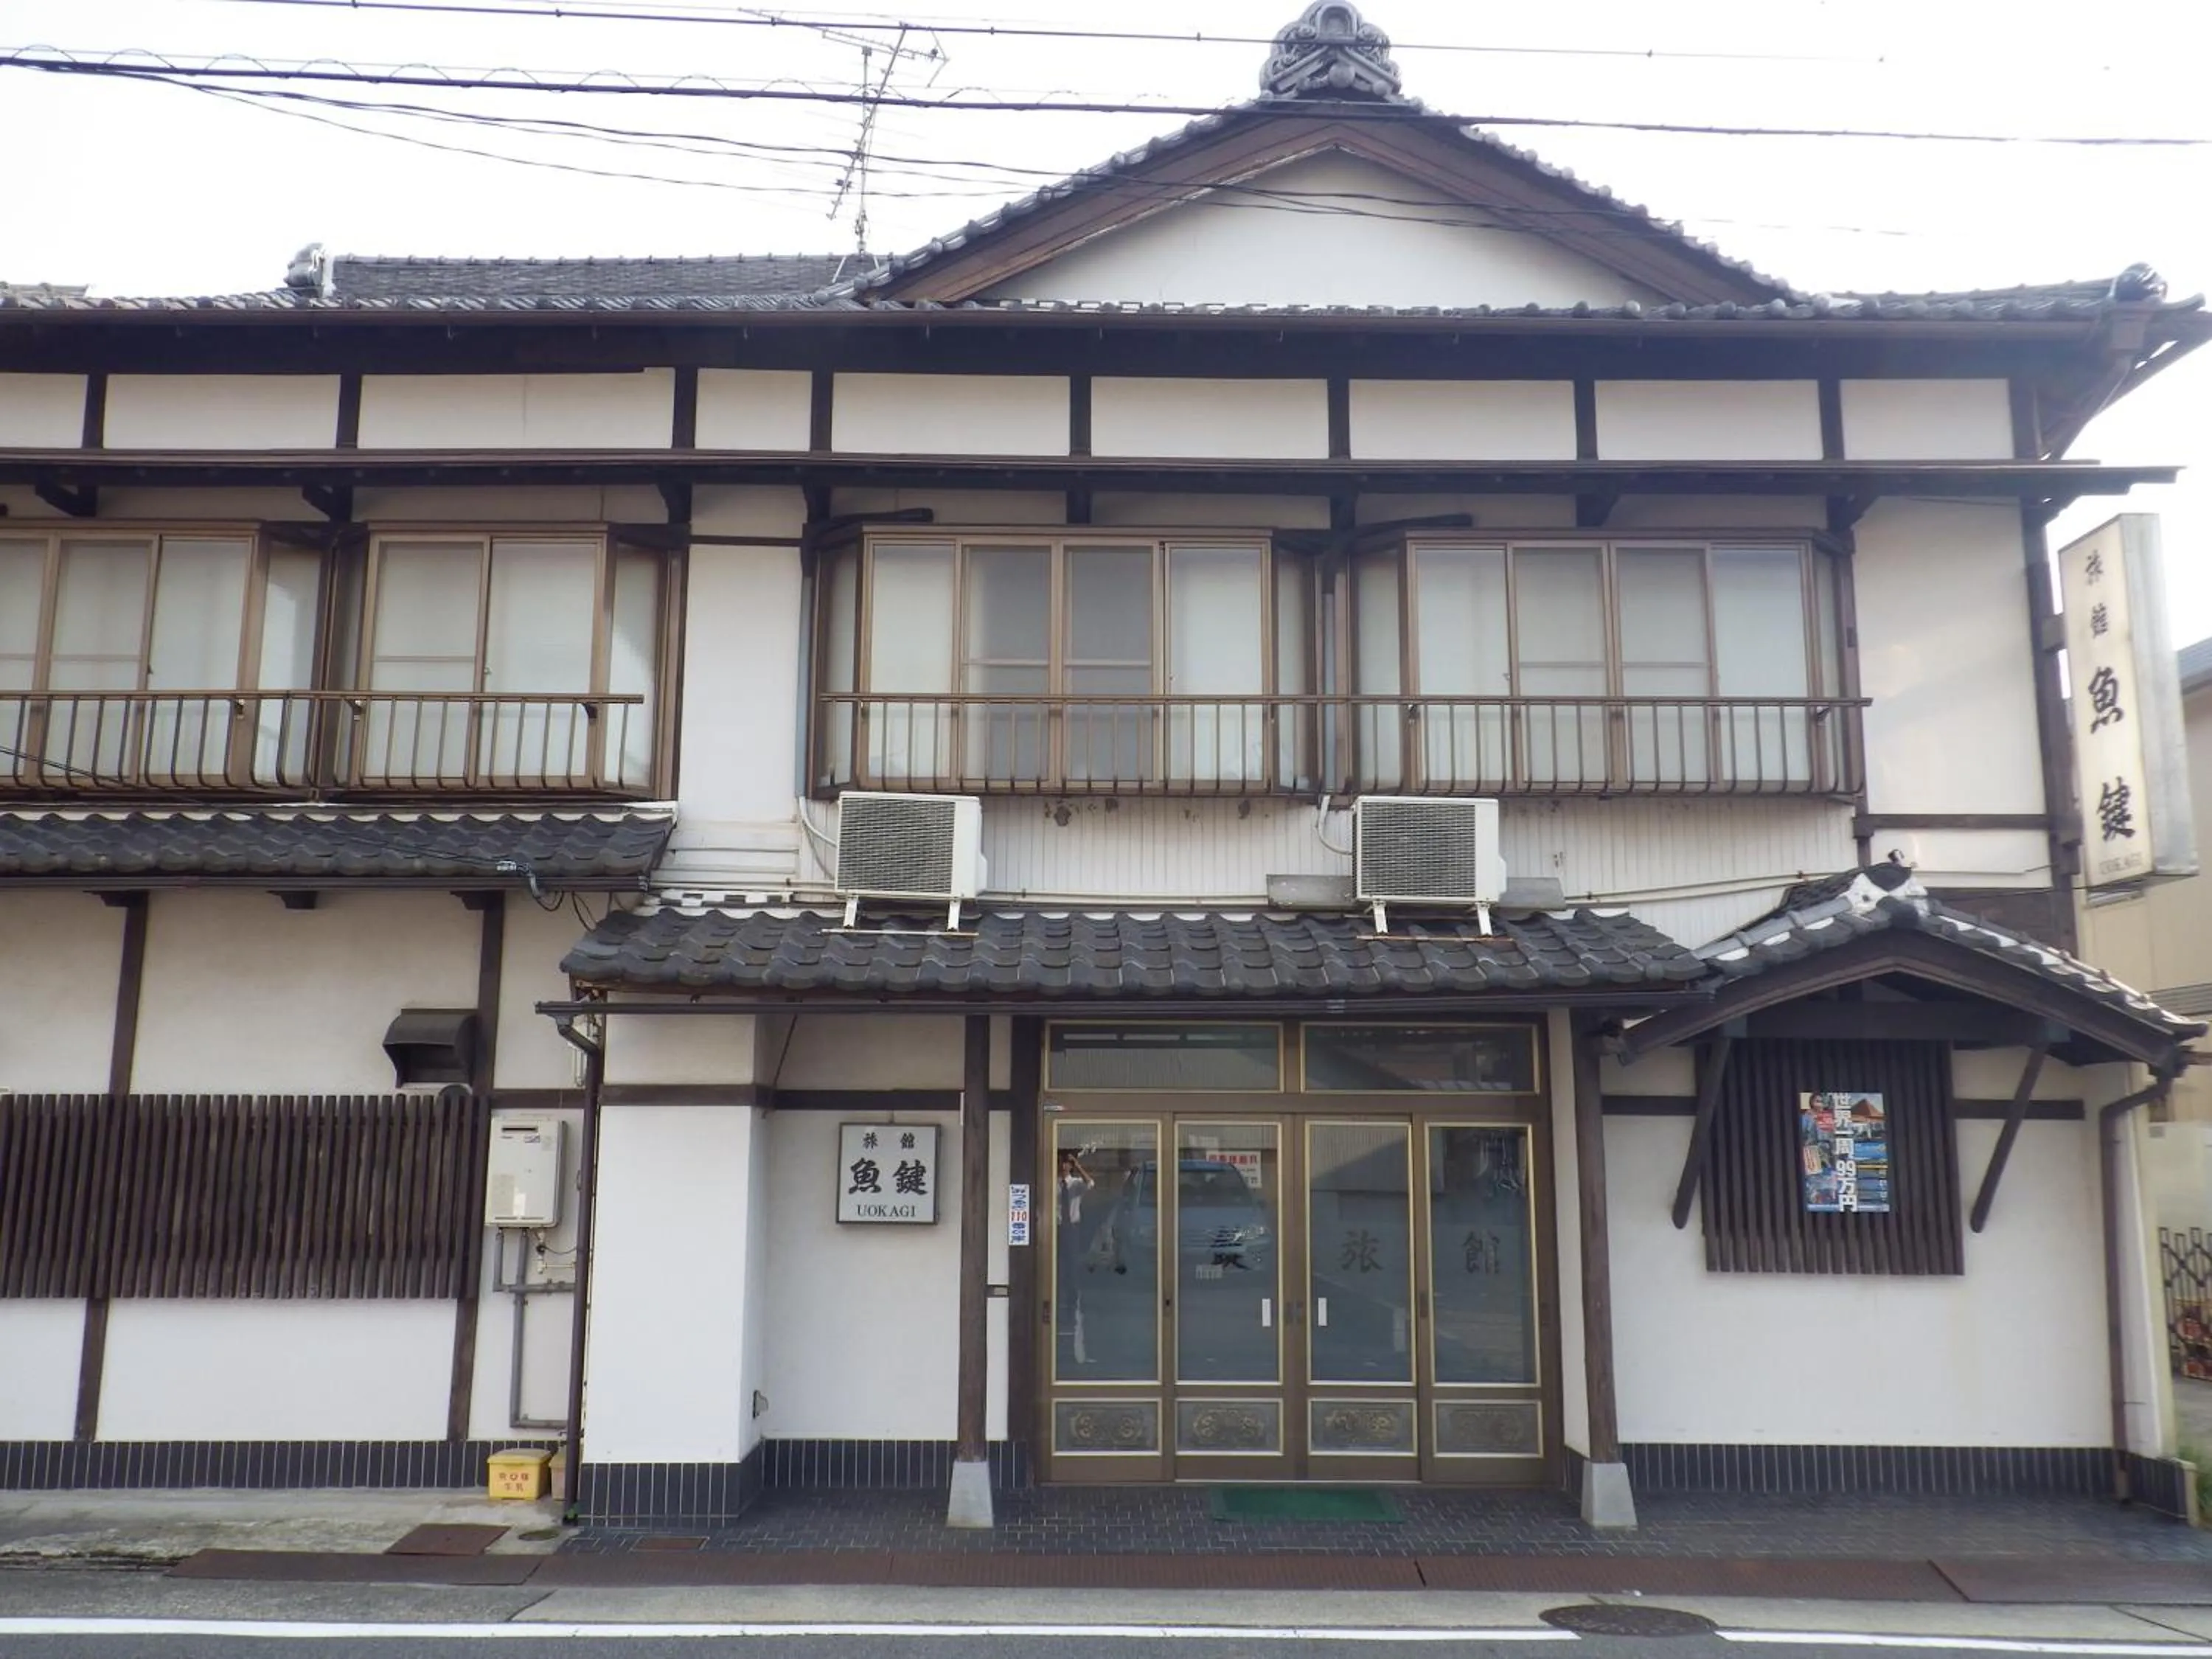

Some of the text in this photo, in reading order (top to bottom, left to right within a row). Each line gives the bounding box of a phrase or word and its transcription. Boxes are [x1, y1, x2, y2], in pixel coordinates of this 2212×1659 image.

[863, 1132, 916, 1150] 旅館
[848, 1157, 928, 1195] 魚鍵
[856, 1204, 917, 1217] UOKAGI
